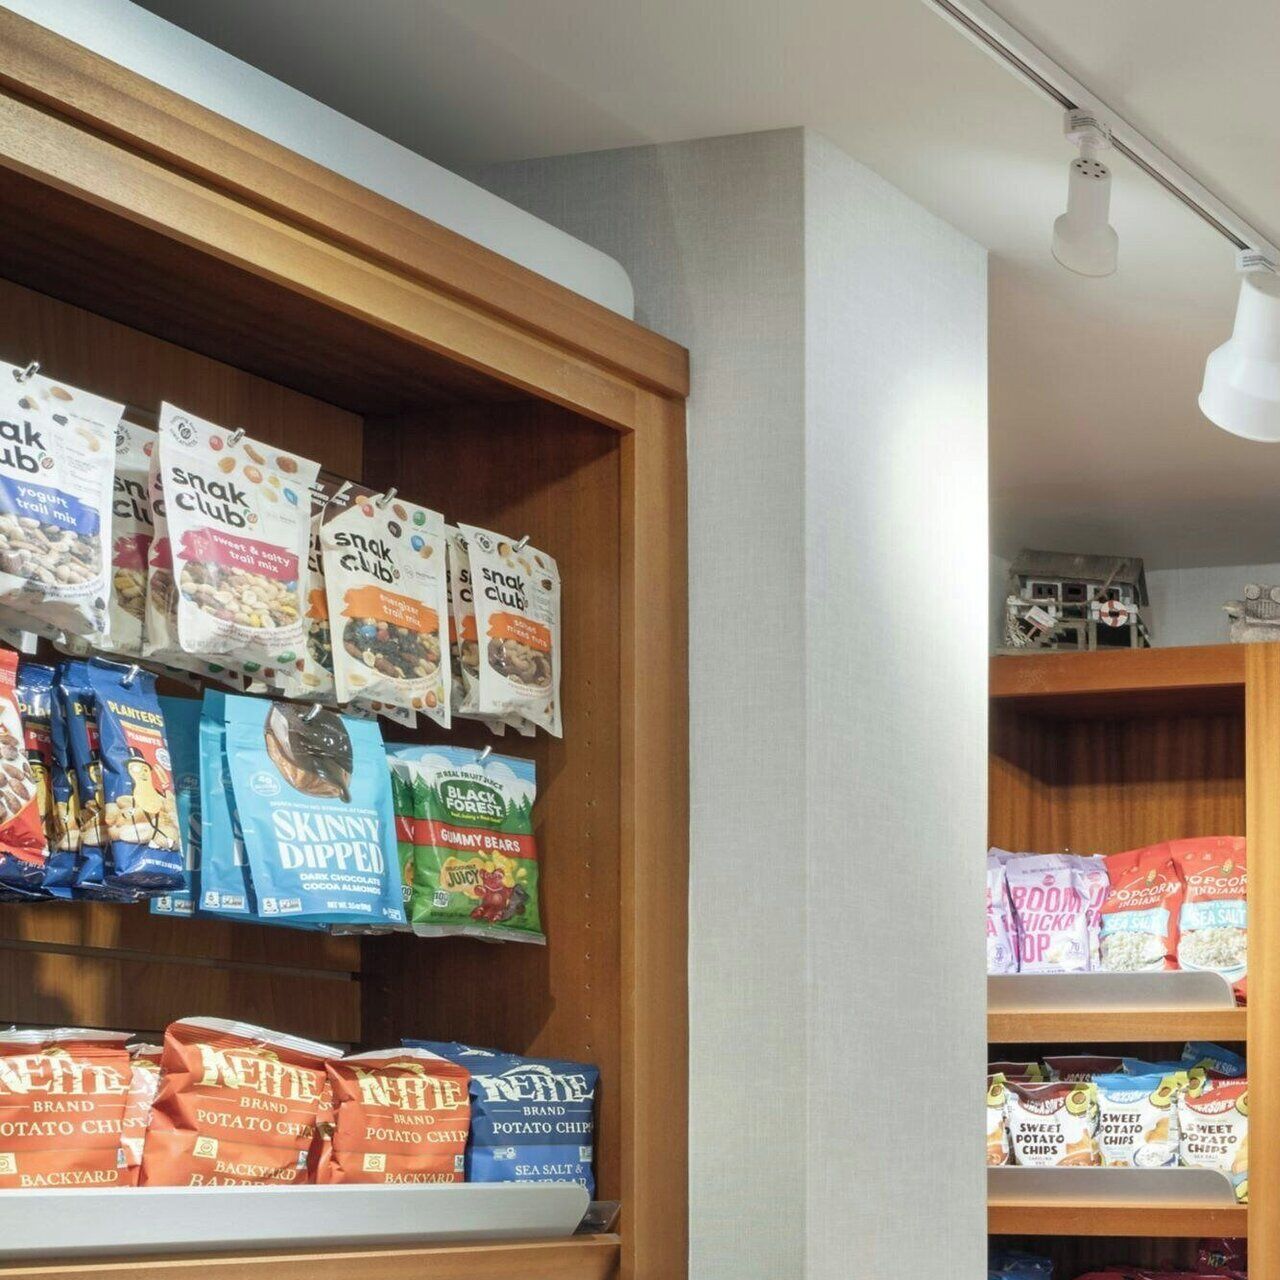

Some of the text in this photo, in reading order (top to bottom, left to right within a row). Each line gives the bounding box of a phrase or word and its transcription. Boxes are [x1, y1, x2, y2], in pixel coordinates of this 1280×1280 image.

[172, 467, 249, 508] snak
[17, 485, 69, 508] yogurt
[16, 498, 77, 527] trail mix
[175, 492, 246, 529] club
[213, 534, 246, 551] sweet
[262, 545, 291, 568] salty
[334, 532, 393, 563] snak
[230, 551, 279, 573] trail mix
[340, 554, 393, 583] club
[482, 567, 525, 592] snak
[485, 587, 526, 611] club
[108, 700, 164, 728] PLANTERS
[442, 770, 459, 779] REAL
[461, 771, 483, 782] FRUIT
[447, 786, 496, 804] BLACK
[446, 798, 503, 817] FOREST
[272, 809, 380, 842] SKINNY
[440, 829, 520, 853] GUMMY BEARS
[277, 842, 385, 875] DIPPED
[300, 872, 381, 887] DARK CHOCOLATE
[447, 870, 480, 887] JUICY
[303, 882, 382, 896] COCOA ALMONDS
[1108, 881, 1181, 901] POPCORN
[1012, 886, 1081, 914] BOOM
[1106, 918, 1129, 932] SEA
[1192, 908, 1248, 926] SEA SALT
[194, 1044, 320, 1103] KETTLE
[356, 1069, 469, 1111] KETTLE
[471, 1072, 594, 1103] KETTLE
[33, 1101, 95, 1113] BRAND
[240, 1097, 288, 1114] BRAND
[523, 1106, 565, 1116] BRAND
[196, 1109, 272, 1132] POTATO
[394, 1114, 435, 1125] BRAND
[1102, 1113, 1142, 1124] SWEET
[0, 1119, 122, 1136] OTATO CHI
[366, 1127, 468, 1143] POTATO CHIP
[492, 1122, 551, 1134] POTATO
[1019, 1123, 1062, 1133] SWEET
[1100, 1124, 1143, 1134] POTATO
[1185, 1124, 1234, 1134] SWEET
[1016, 1134, 1065, 1144] POTATO
[1103, 1135, 1134, 1145] CHIPS
[1180, 1133, 1238, 1144] POTATO
[1022, 1145, 1058, 1155] CHIPS
[1187, 1143, 1228, 1154] CHIPS
[20, 1170, 118, 1187] BACKYARD
[215, 1160, 296, 1181] BACKYARD
[385, 1172, 455, 1183] BACKYARD
[515, 1165, 584, 1175] SEA SALT &
